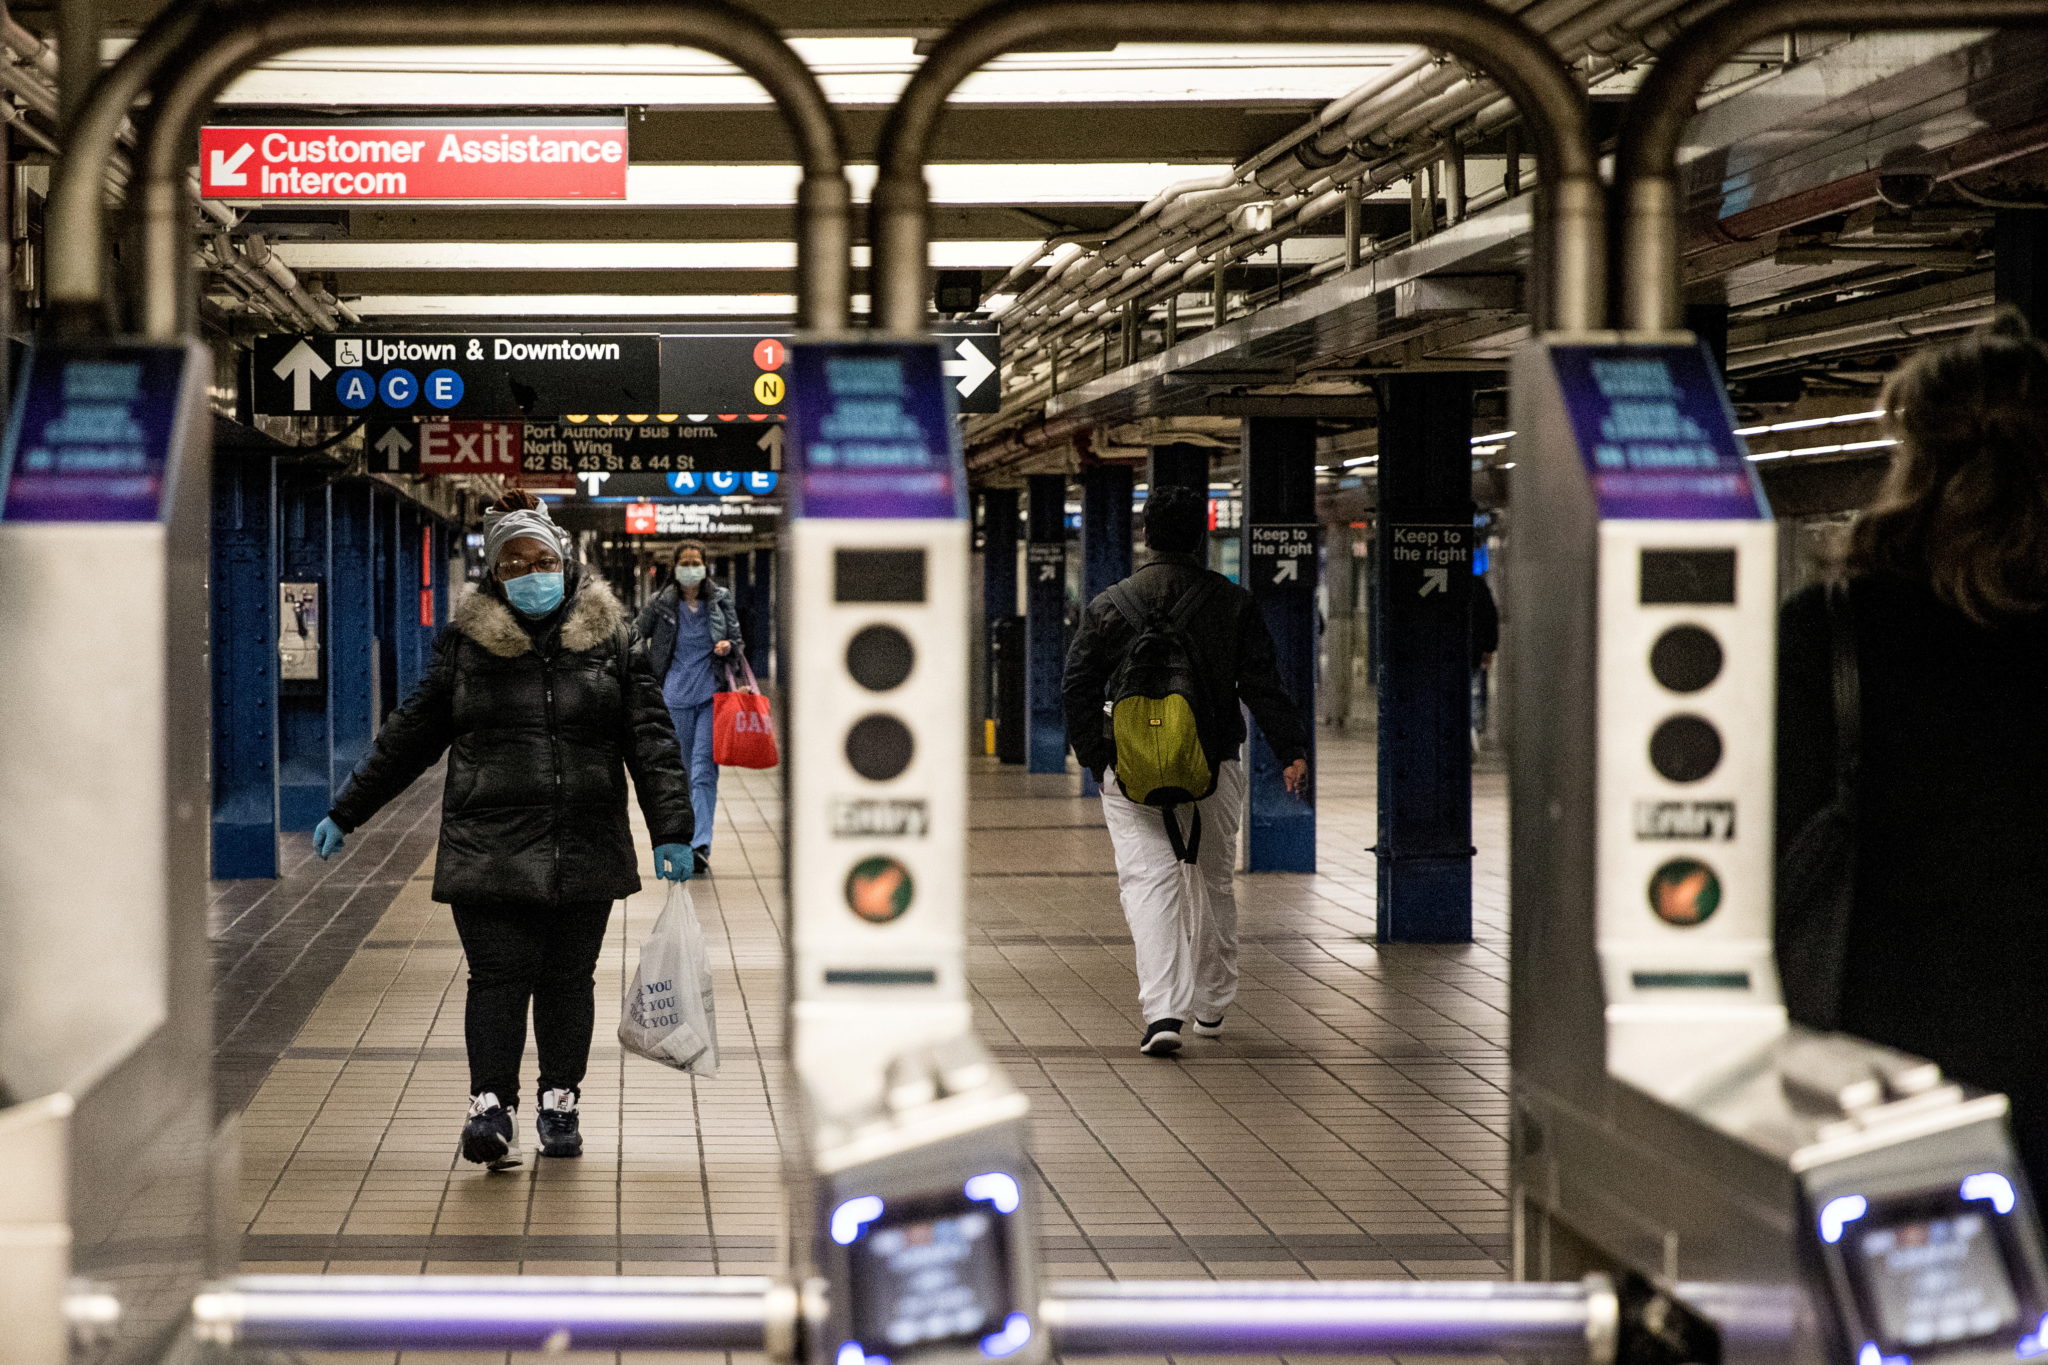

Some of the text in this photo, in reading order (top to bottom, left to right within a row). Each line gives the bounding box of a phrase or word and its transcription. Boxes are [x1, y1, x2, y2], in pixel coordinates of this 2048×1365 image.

[262, 133, 622, 163] Customer Assistance
[261, 165, 407, 194] Intercom
[365, 339, 620, 364] Uptown & Downtown
[763, 346, 774, 365] 1
[346, 376, 453, 400] A C E
[763, 381, 777, 398] N
[523, 424, 556, 439] Port
[420, 424, 514, 464] Exit
[523, 440, 613, 457] North Wing
[523, 456, 695, 473] 42 St, 43 St & 44 St
[674, 471, 769, 488] A C E
[1253, 528, 1308, 543] Keep to
[1394, 528, 1461, 547] Keep to
[1252, 542, 1313, 558] the right
[1393, 546, 1467, 565] the right
[646, 980, 672, 994] YOU
[649, 996, 675, 1011] YOU
[651, 1013, 678, 1028] YOU
